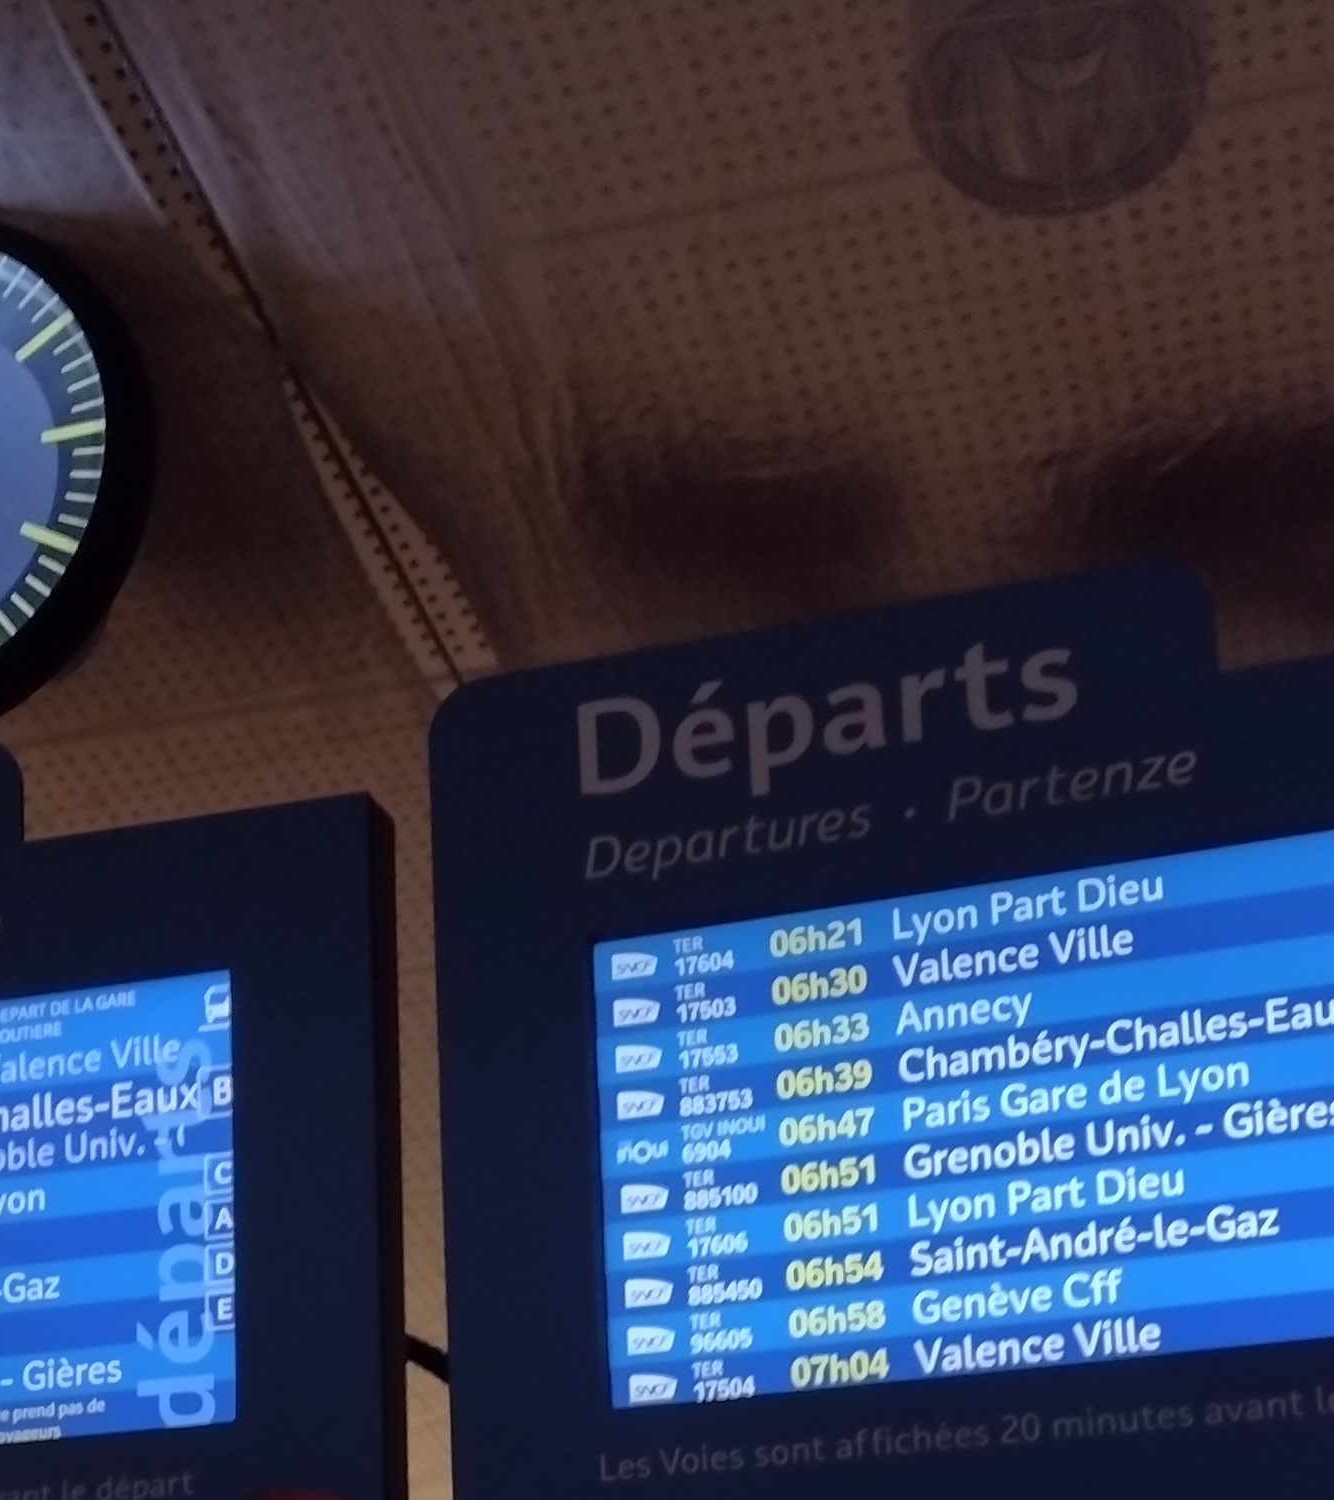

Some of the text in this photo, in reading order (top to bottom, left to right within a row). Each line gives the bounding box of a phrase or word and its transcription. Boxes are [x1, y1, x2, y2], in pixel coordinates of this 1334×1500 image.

[577, 642, 1078, 797] Départs
[584, 750, 1197, 880] Departures Partenze
[892, 874, 1164, 946] Lyon Part Dieu
[673, 936, 703, 954] TER
[770, 918, 863, 957] 06h21
[893, 925, 1133, 987] Valence Ville
[674, 952, 734, 976] 17604
[675, 983, 705, 1000] TER
[771, 964, 867, 1006] 06h30
[676, 998, 737, 1023] 17503
[896, 992, 1033, 1036] Annecy
[110, 1033, 182, 1068] Ville
[677, 1030, 707, 1047] TER
[774, 1012, 870, 1052] 06h33
[678, 1044, 739, 1070] 17553
[213, 1076, 231, 1106] B
[679, 1076, 710, 1093] TER
[777, 1059, 872, 1099] 06h39
[904, 1059, 1249, 1130] Paris Gare de Lyon
[64, 1126, 145, 1165] Univ.
[681, 1123, 714, 1141] TGV
[779, 1107, 874, 1147] 06h47
[682, 1139, 731, 1163] 6904
[904, 1129, 1074, 1180] Grenoble
[1086, 1116, 1186, 1156] Univ.
[214, 1161, 232, 1185] C
[683, 1169, 714, 1187] TER
[781, 1155, 876, 1195] 06h51
[215, 1208, 234, 1230] A
[908, 1168, 1184, 1235] Lyon Part Dieu
[685, 1217, 716, 1236] TER
[784, 1204, 878, 1242] 06h51
[910, 1203, 1280, 1277] Saint-André-le-Gaz
[216, 1253, 235, 1275] D
[687, 1264, 718, 1283] TER
[786, 1250, 883, 1290] 06h54
[218, 1298, 233, 1320] E
[913, 1268, 1122, 1326] Genève Cff
[690, 1312, 721, 1330] TER
[788, 1299, 885, 1338] 06h58
[915, 1316, 1161, 1376] Valence Ville
[23, 1357, 122, 1392] Gières
[691, 1360, 723, 1378] TER
[791, 1348, 889, 1389] 07h04
[600, 1454, 650, 1483] Les
[659, 1443, 744, 1475] Voies
[755, 1438, 826, 1466] sont
[837, 1421, 989, 1461] affichées
[1001, 1414, 1039, 1444] 20
[1053, 1404, 1193, 1438] minutes
[1206, 1393, 1304, 1426] avant
